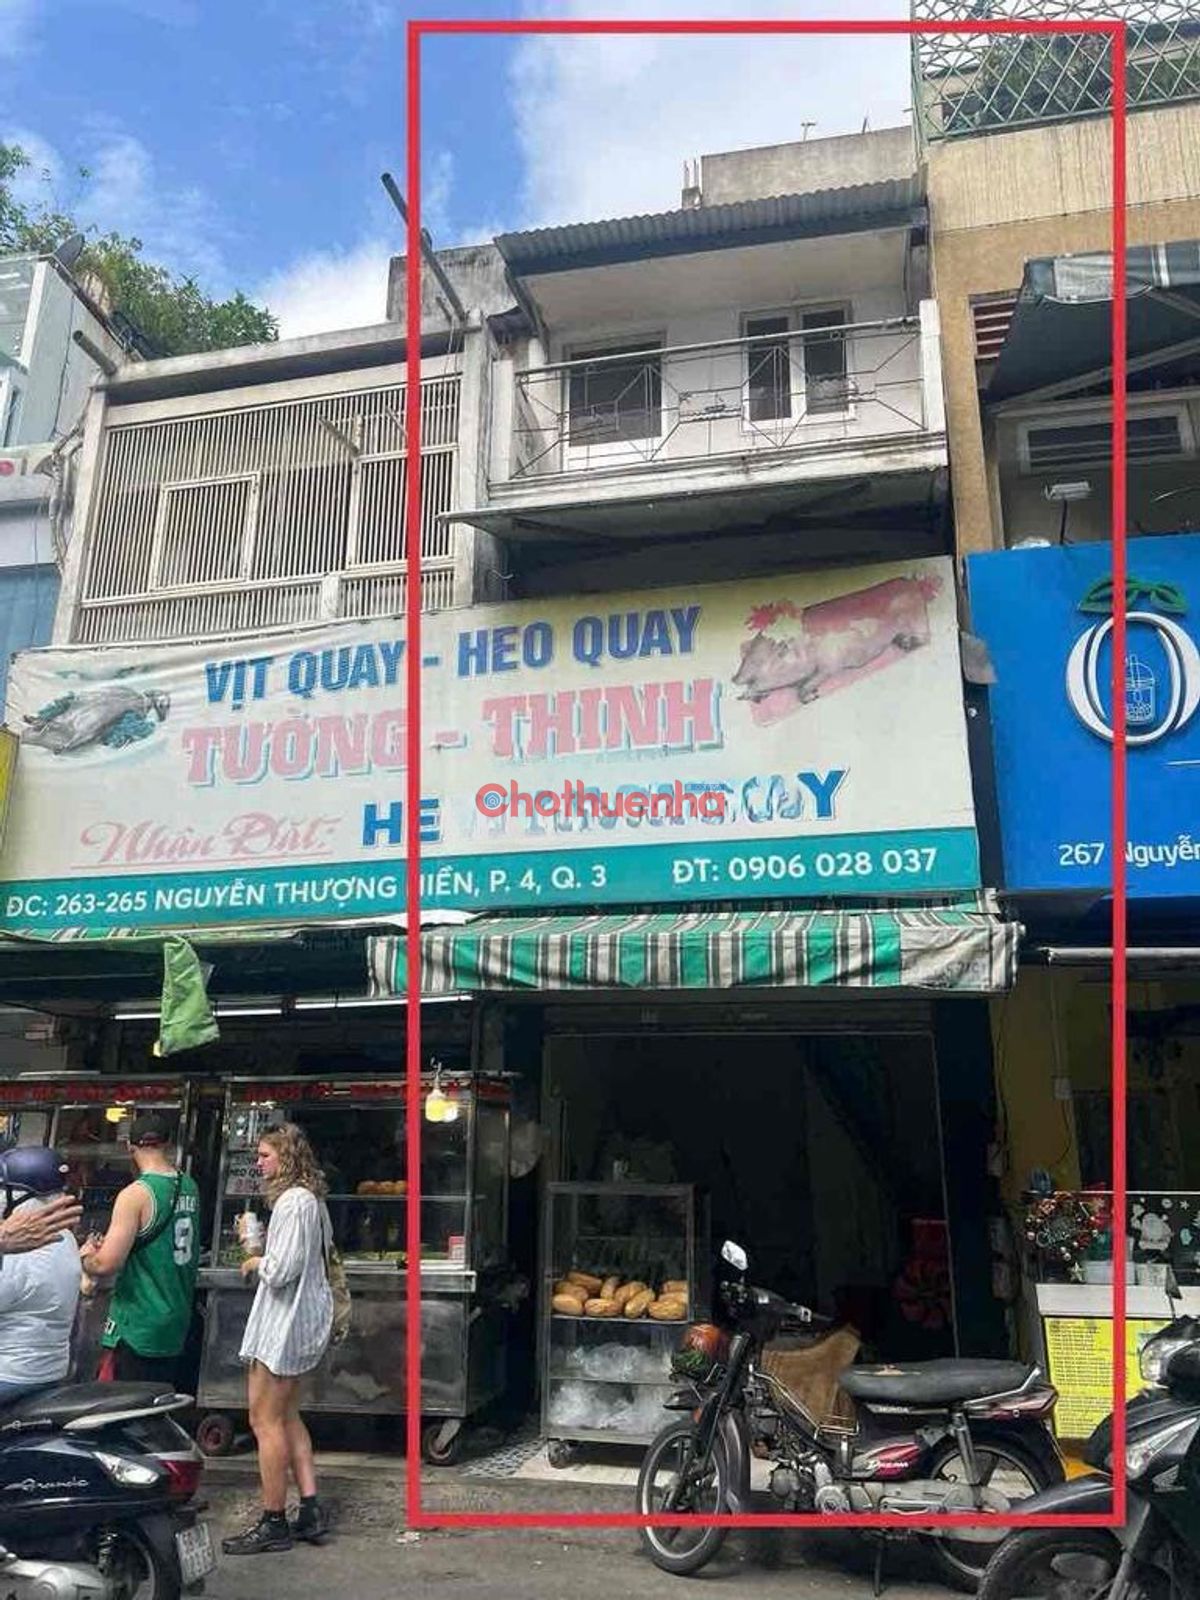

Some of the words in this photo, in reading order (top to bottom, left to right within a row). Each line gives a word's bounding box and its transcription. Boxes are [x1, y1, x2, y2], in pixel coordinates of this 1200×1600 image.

[205, 656, 274, 710] VỊT
[287, 639, 405, 699] QUAY
[457, 621, 553, 677] HEO
[572, 605, 701, 668] QUAY
[672, 857, 720, 884] ĐT:
[728, 853, 806, 881] 0906
[815, 851, 873, 877] 028
[881, 847, 938, 874] 037
[1058, 843, 1105, 866] 267
[6, 895, 48, 917] ĐC:
[54, 890, 147, 915] 263-265
[154, 877, 265, 911] NGUYỄN
[274, 875, 399, 908] THƯỢNG
[489, 869, 511, 893] P.
[519, 868, 541, 896] 4,
[551, 865, 582, 889] Q.
[590, 864, 607, 888] 3
[173, 1217, 194, 1266] 9
